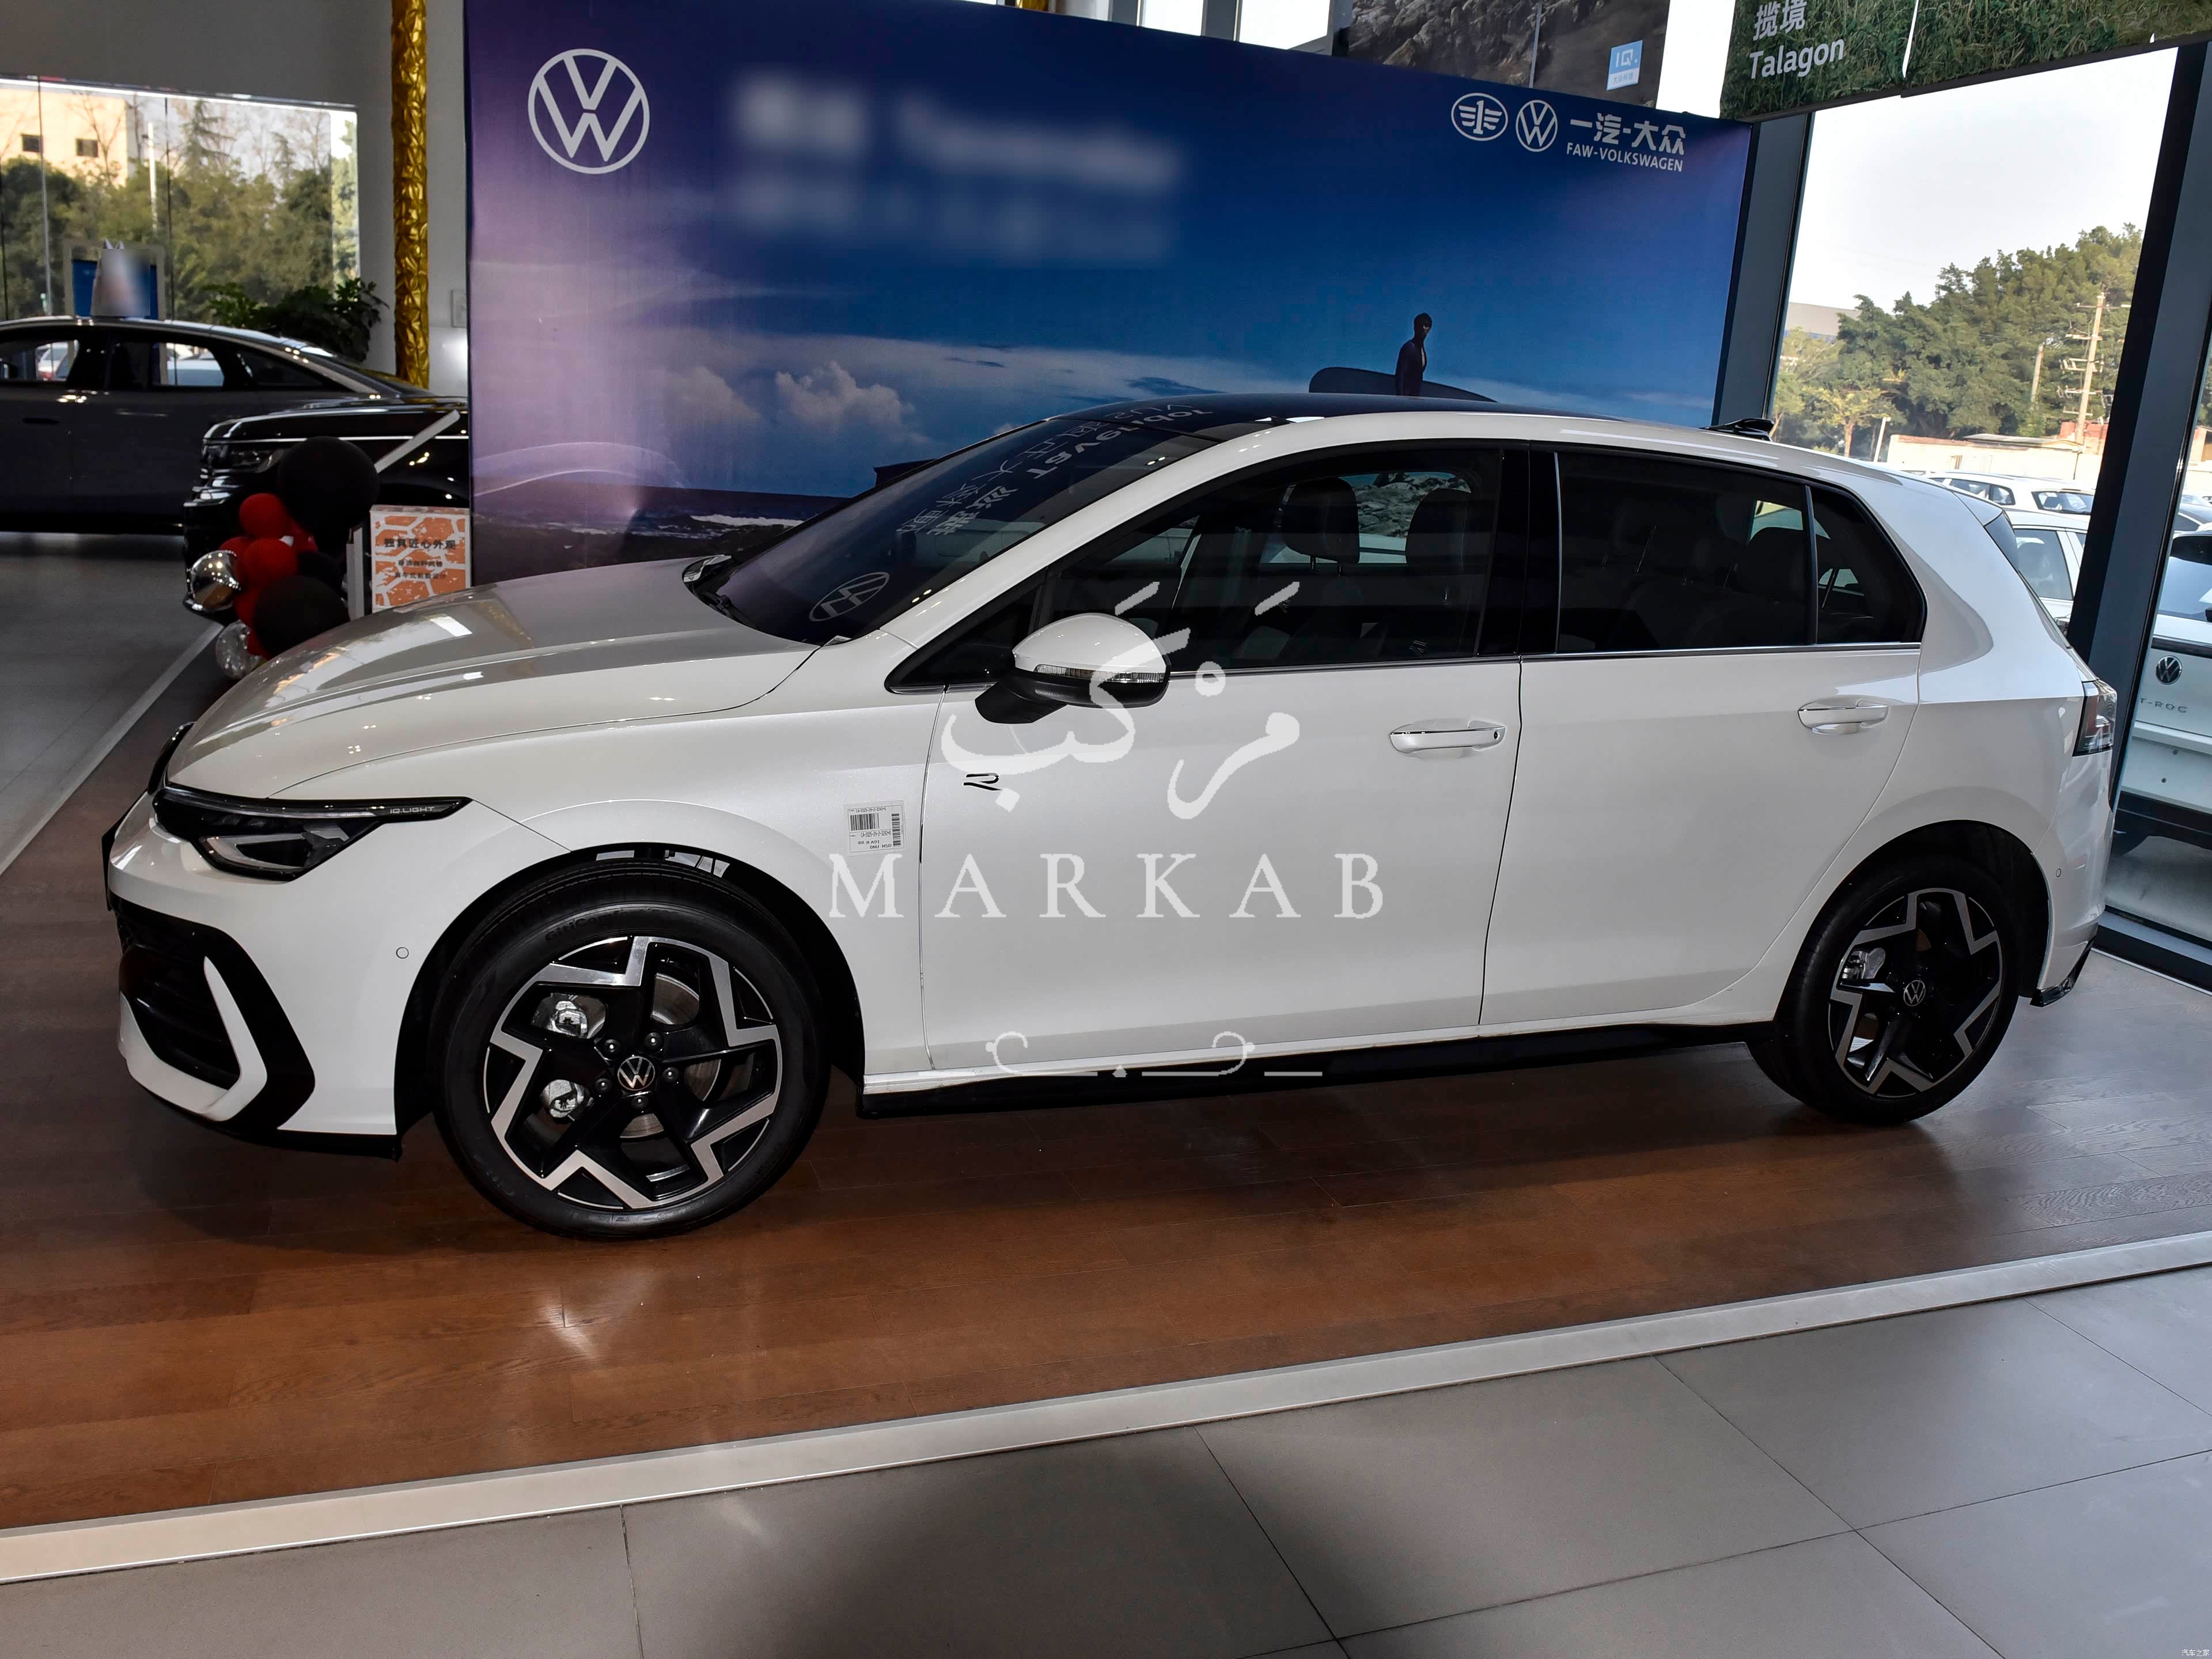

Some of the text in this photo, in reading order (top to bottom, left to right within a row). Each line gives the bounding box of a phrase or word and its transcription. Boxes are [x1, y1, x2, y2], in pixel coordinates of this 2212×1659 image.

[1752, 0, 1808, 41] 揽境
[1750, 38, 1844, 79] Talagon
[1566, 142, 1683, 172] FAW-VOLKSWAGEN
[2140, 698, 2188, 713] T-ROC
